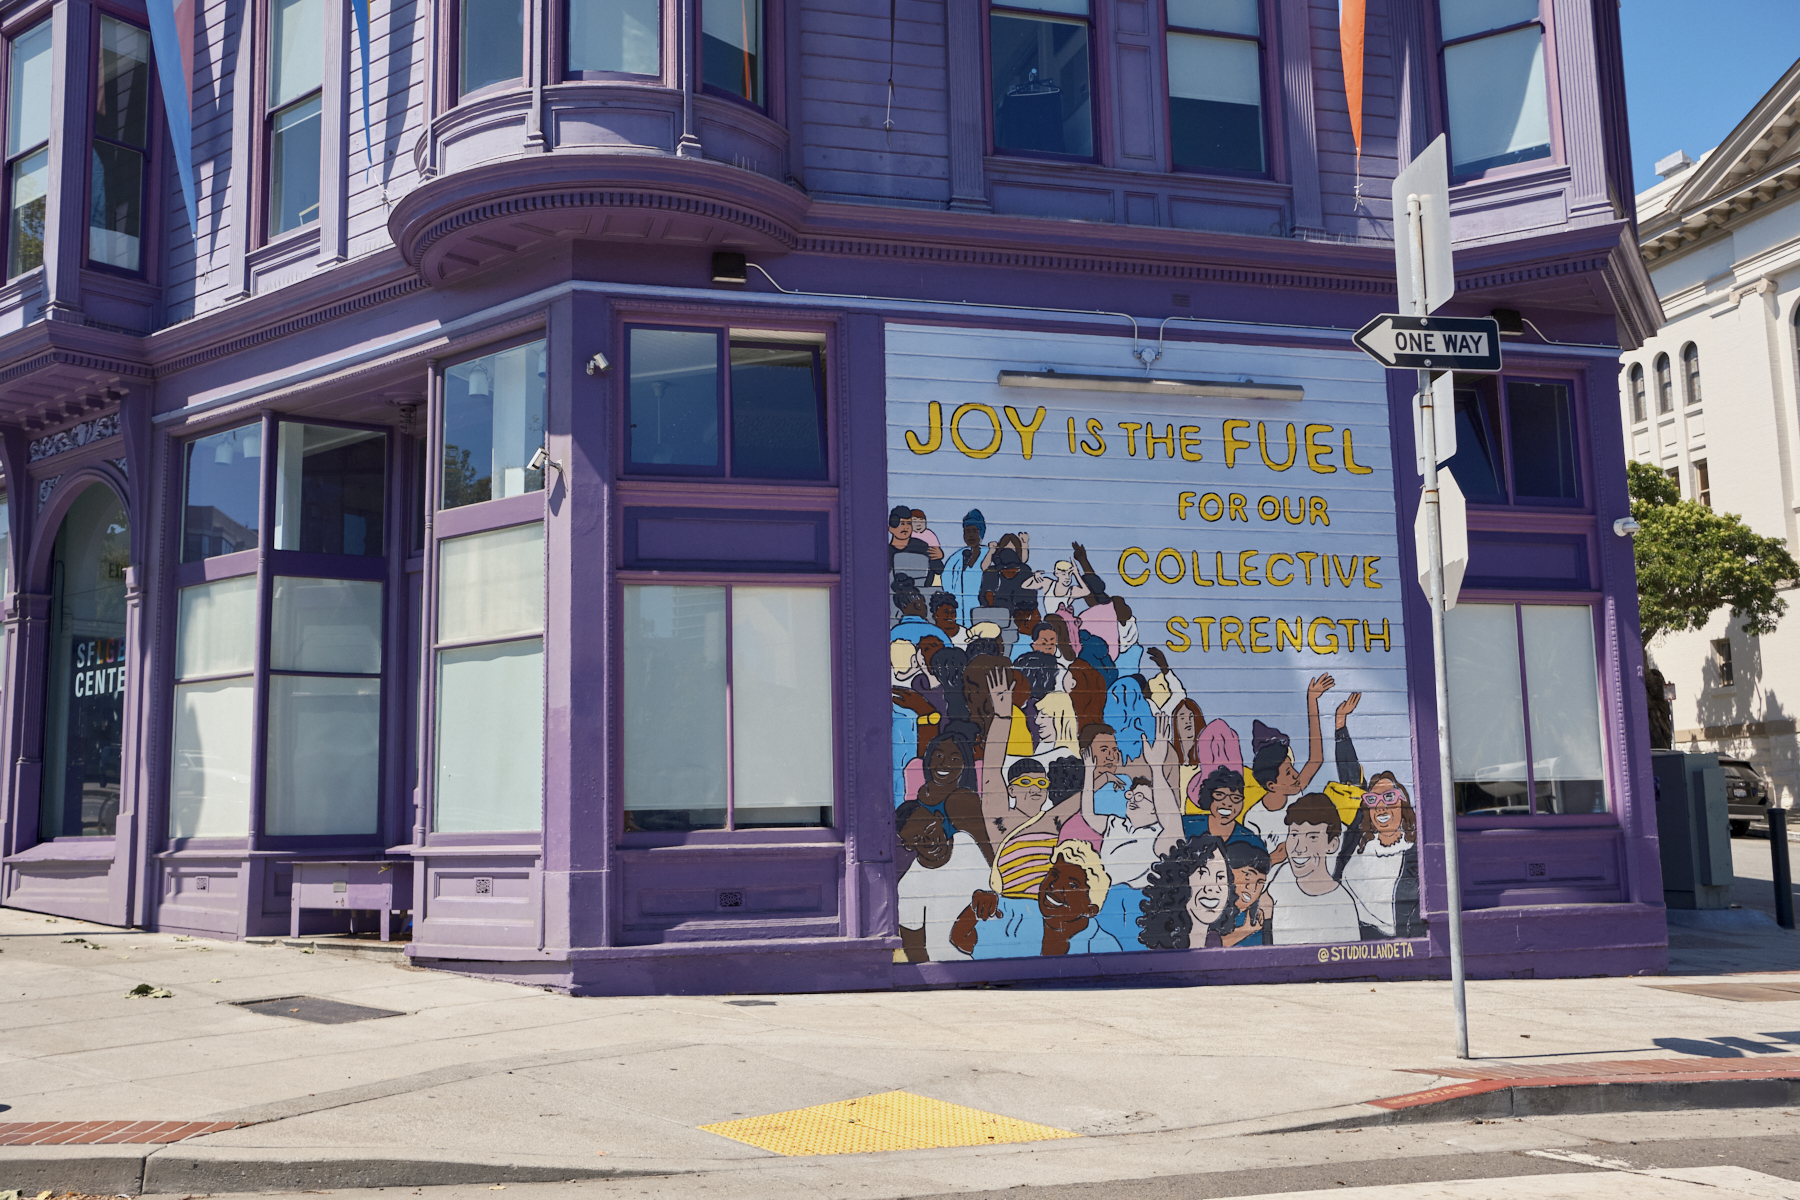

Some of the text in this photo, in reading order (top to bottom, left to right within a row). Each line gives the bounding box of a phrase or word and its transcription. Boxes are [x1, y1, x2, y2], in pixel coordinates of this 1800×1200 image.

[1395, 331, 1483, 354] ONE WAY
[905, 400, 1373, 475] JOY IS THE FUEL
[1178, 491, 1330, 526] FOR OUR
[108, 562, 126, 579] EXI
[1118, 546, 1383, 589] COLLECTIVE
[1166, 615, 1391, 655] STRENGTH
